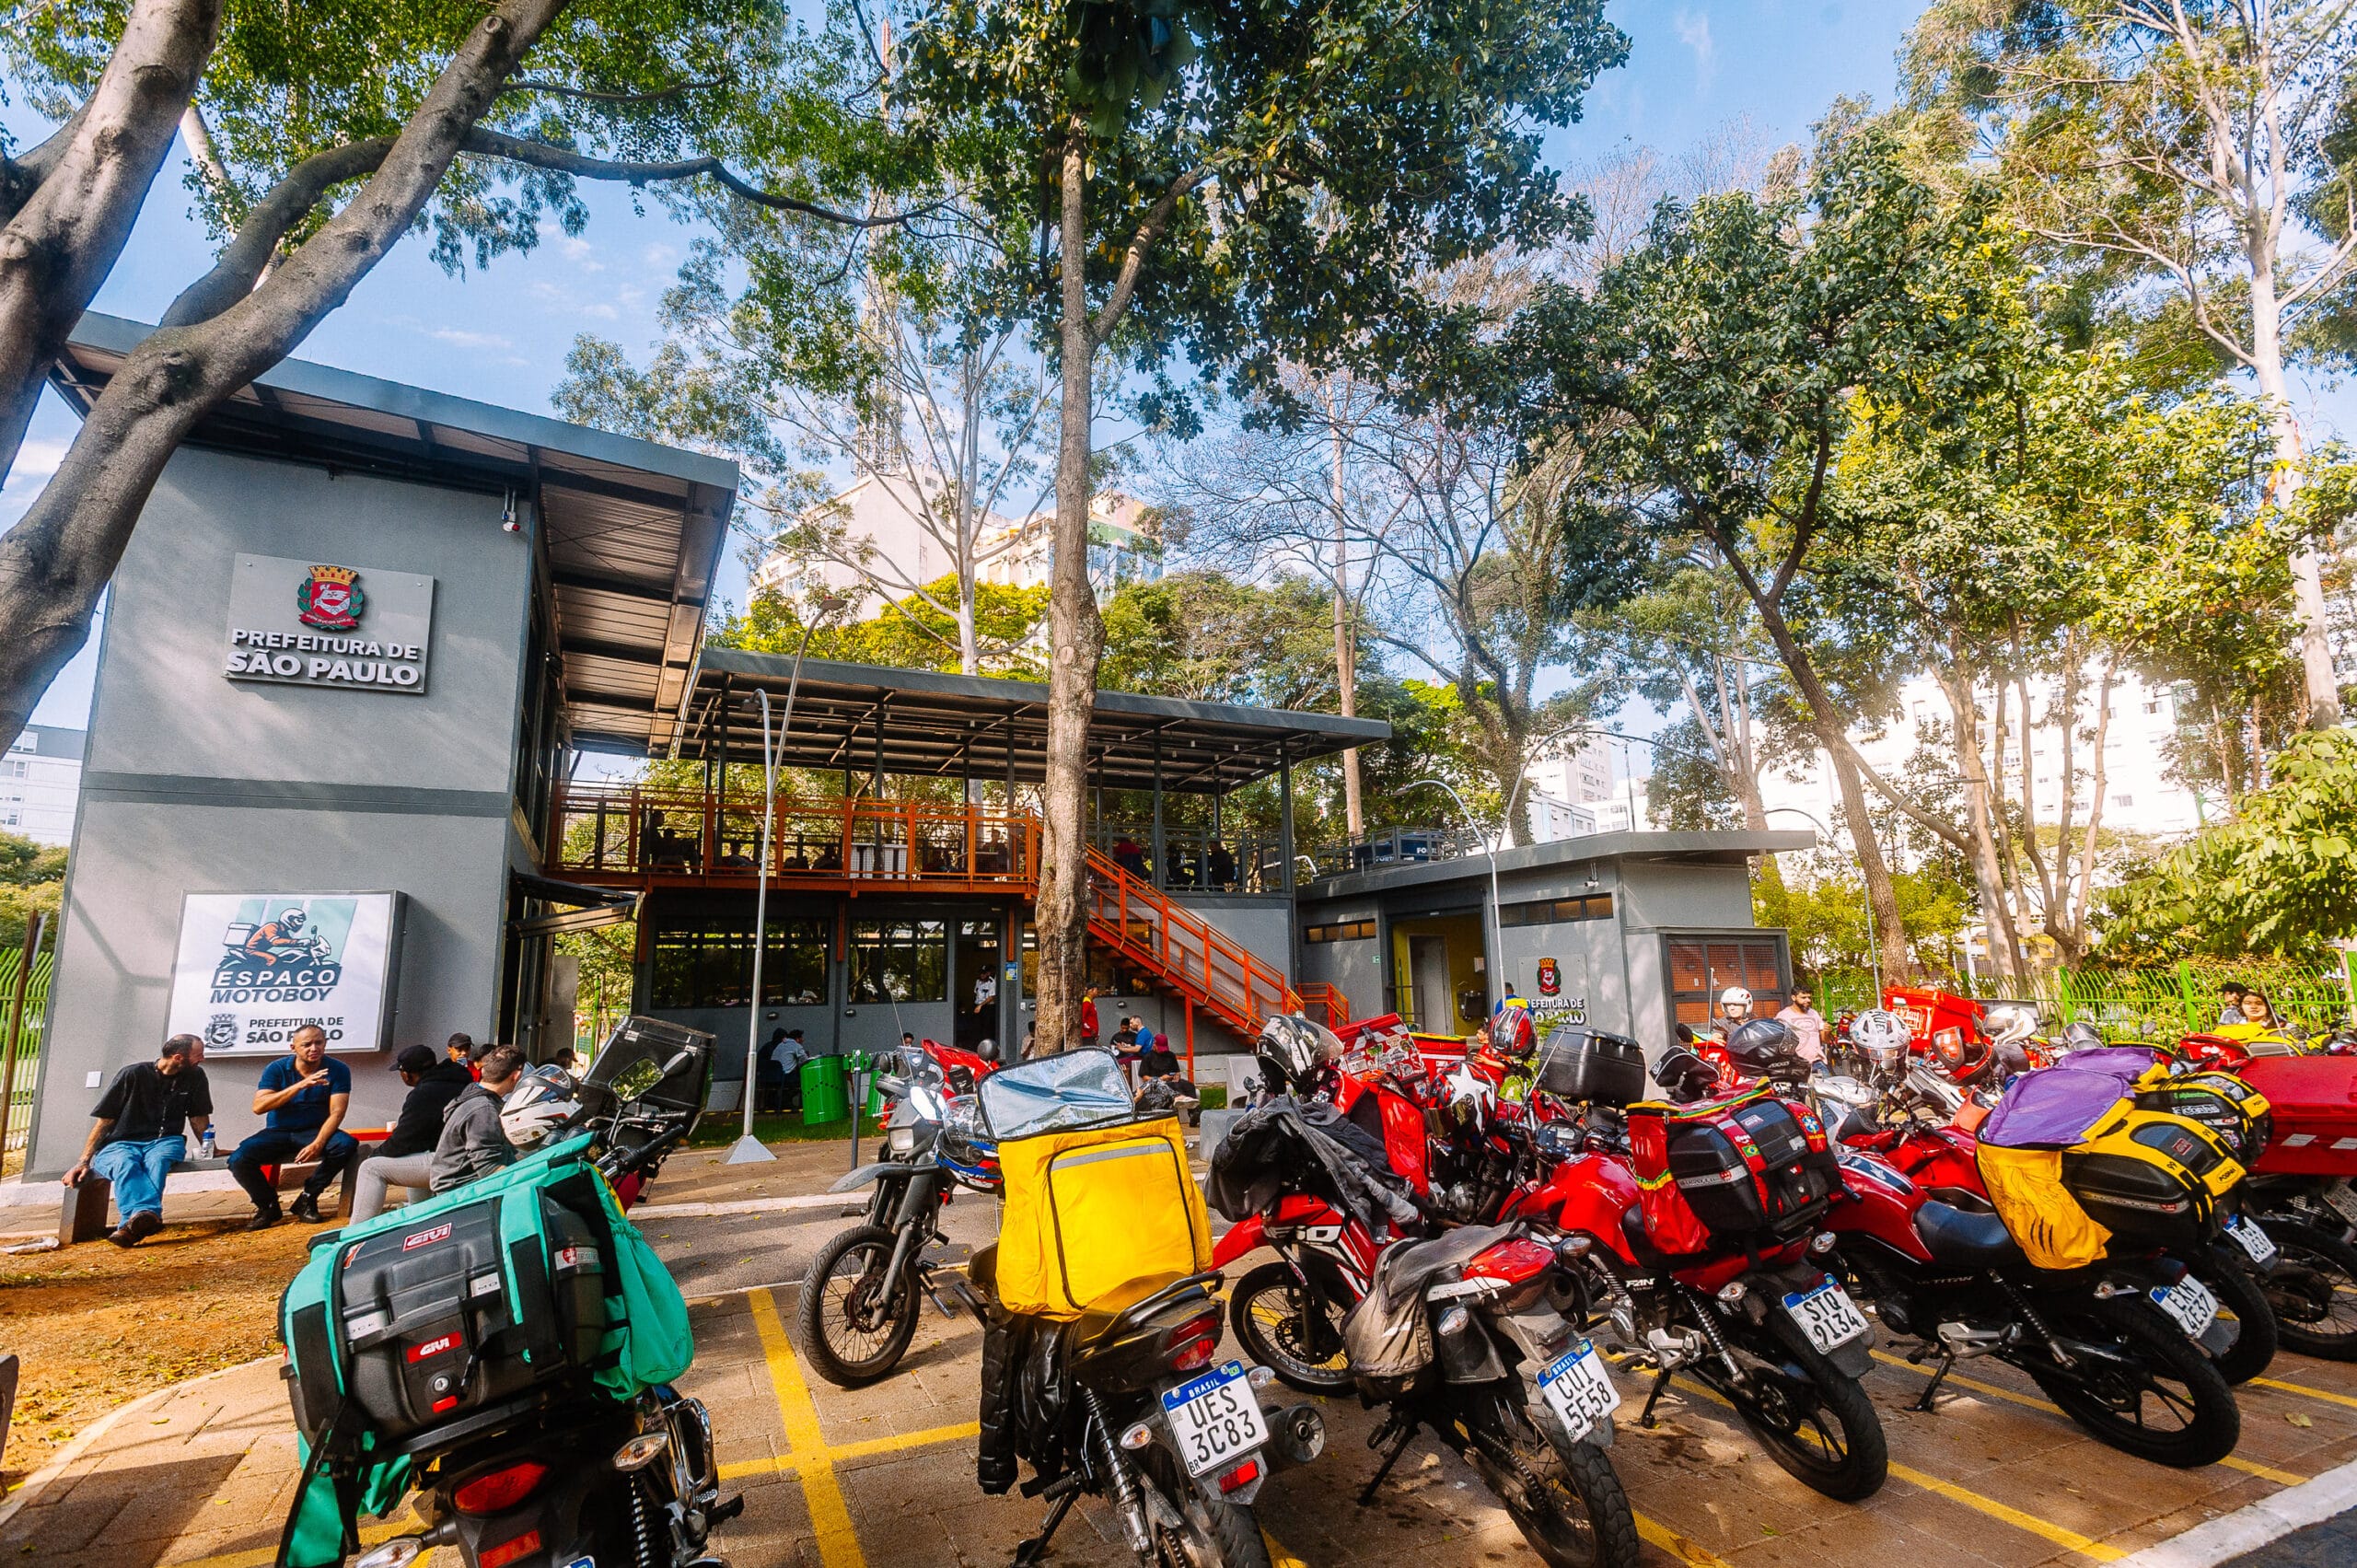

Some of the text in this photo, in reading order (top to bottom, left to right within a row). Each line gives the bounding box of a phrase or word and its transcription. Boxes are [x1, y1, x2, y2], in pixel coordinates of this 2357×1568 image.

[231, 628, 419, 660] PREFEITURA DE
[226, 648, 419, 685] SÃO PAULO
[215, 970, 336, 986] ESPAÇO
[210, 987, 333, 1004] MOTOBOY
[1570, 999, 1584, 1008] DE
[249, 1016, 344, 1028] PREFEITURA DE
[246, 1028, 284, 1044] SÃO
[406, 1226, 448, 1247] GIVI
[1625, 1278, 1655, 1288] FAN
[1803, 1291, 1842, 1321] STQ
[2184, 1292, 2212, 1330] 4E37
[420, 1338, 450, 1356] GIVI
[1551, 1355, 1576, 1376] BRASIL
[1188, 1378, 1221, 1398] BRASIL
[1555, 1362, 1595, 1400] CUI
[1187, 1386, 1237, 1429] UES
[1564, 1381, 1611, 1430] 5E58
[1190, 1409, 1256, 1463] 3C83
[1188, 1459, 1201, 1472] BR
